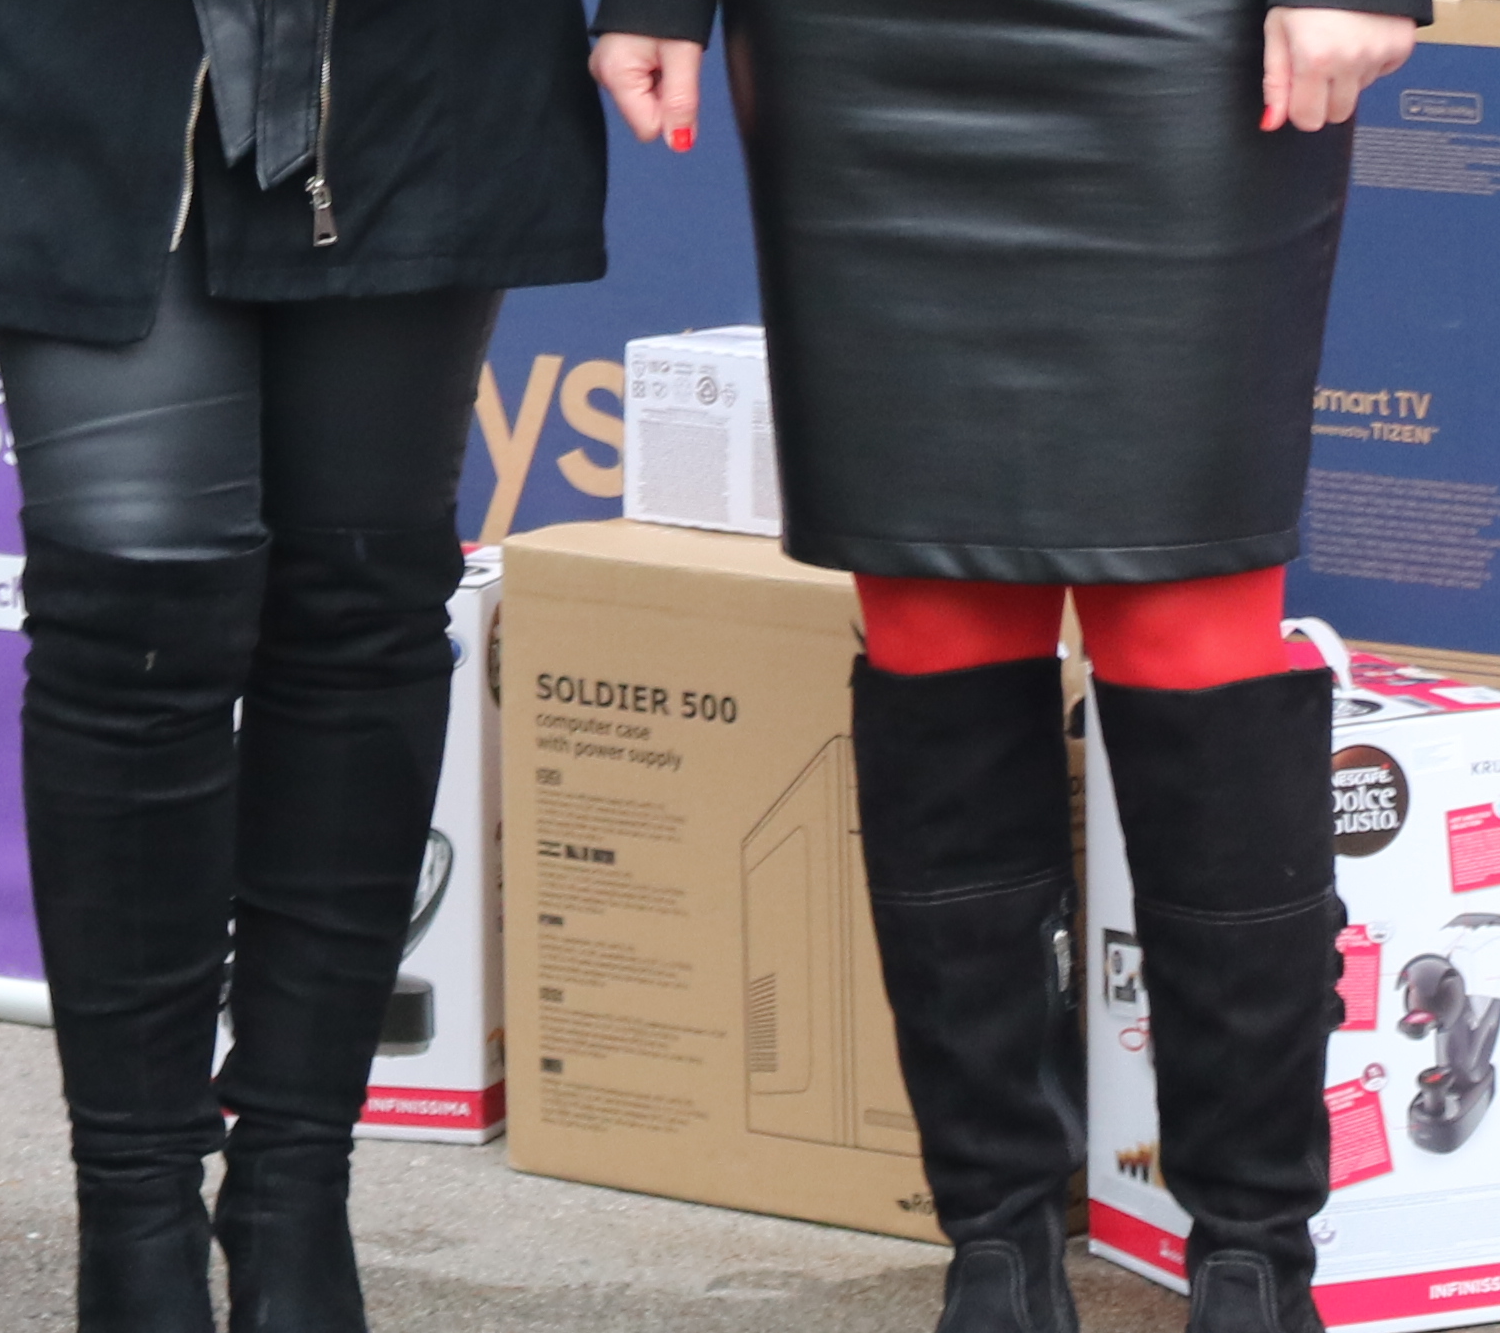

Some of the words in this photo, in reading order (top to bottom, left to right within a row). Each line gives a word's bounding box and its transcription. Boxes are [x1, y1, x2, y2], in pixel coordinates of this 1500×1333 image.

[1394, 389, 1433, 419] TV
[536, 673, 670, 715] SOLDIER
[681, 691, 738, 724] 500
[536, 713, 613, 735] computer
[615, 723, 651, 740] case
[536, 736, 570, 753] with
[575, 741, 624, 759] power
[629, 748, 683, 771] supply
